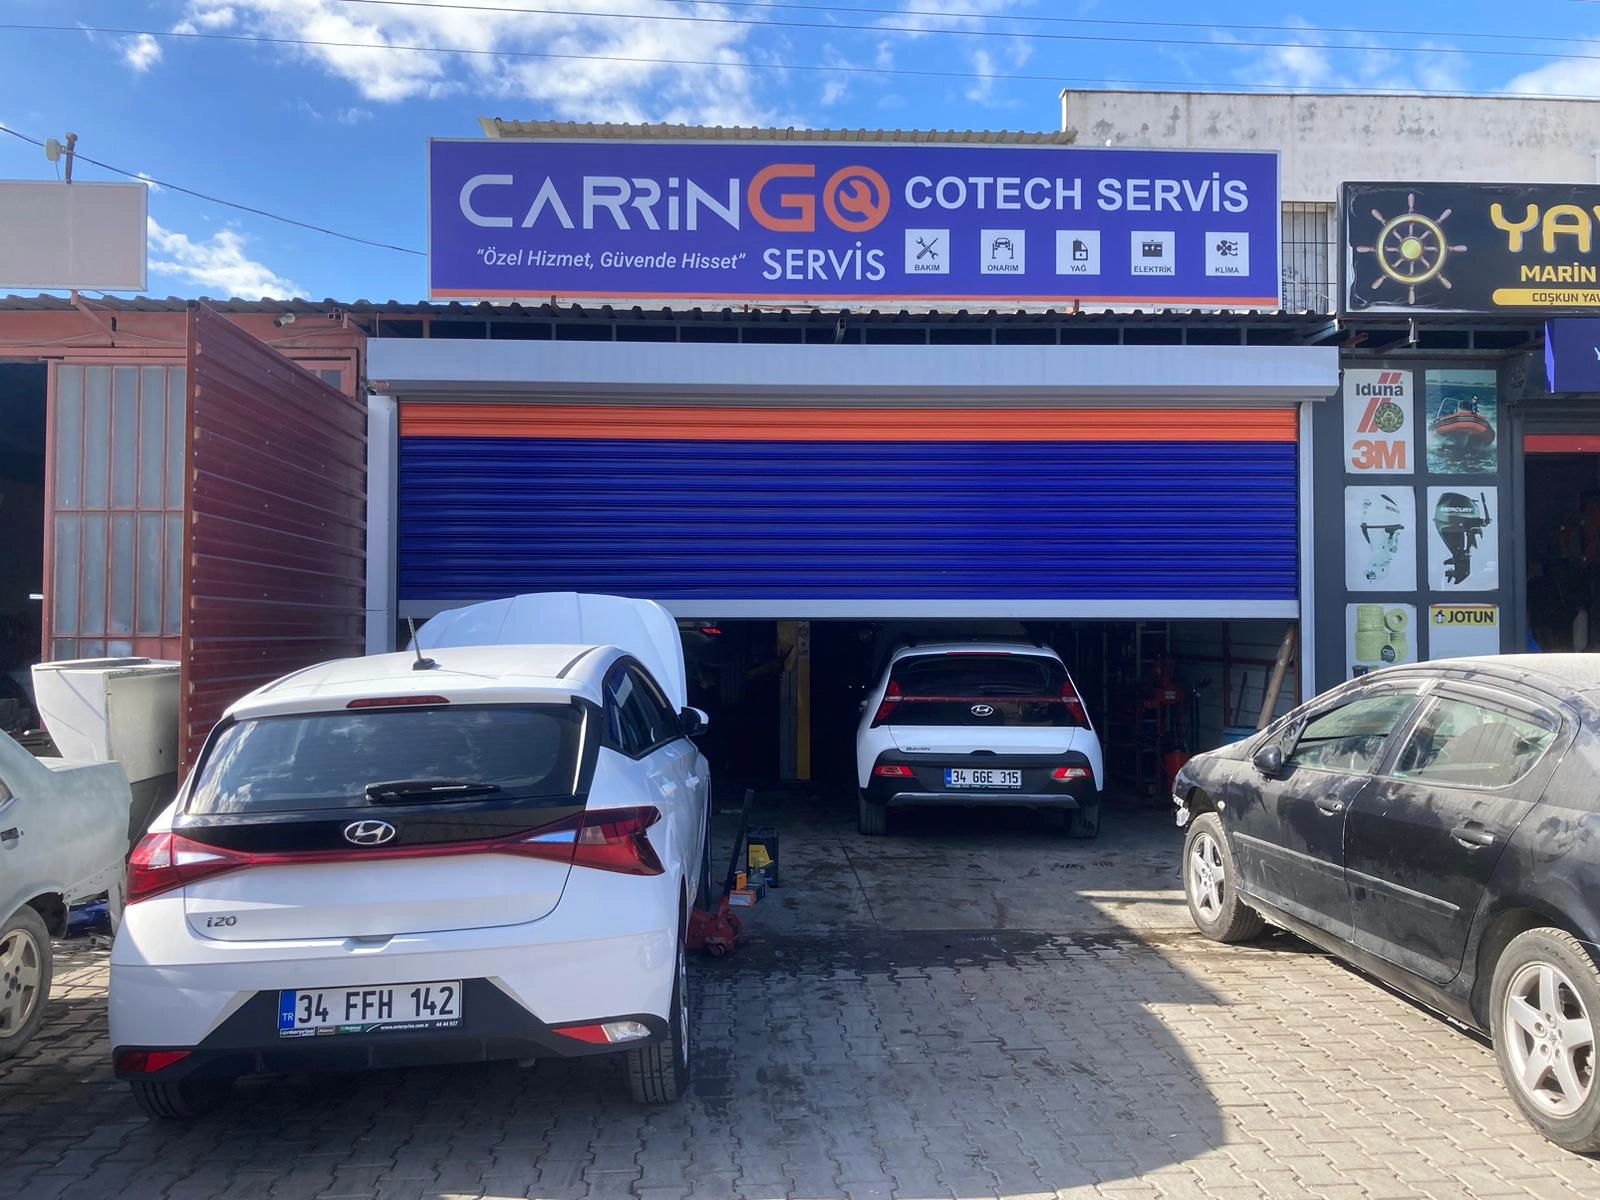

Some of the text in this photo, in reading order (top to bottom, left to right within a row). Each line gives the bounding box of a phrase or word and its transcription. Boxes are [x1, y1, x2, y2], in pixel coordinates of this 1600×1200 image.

[904, 172, 1249, 213] COTECH SERVİS
[1490, 203, 1600, 254] YA
[476, 247, 747, 270] “Özel Hizmet, Güvende Hisset”
[762, 241, 886, 281] SERVİS
[914, 264, 941, 272] BAKIM
[987, 264, 1019, 272] ONARIM
[1070, 263, 1088, 273] YAĞ
[1133, 264, 1173, 274] ELEKTRİK
[1214, 266, 1240, 274] KLİMA
[1532, 292, 1579, 305] COŞKUN
[1356, 383, 1404, 396] Iduna
[1352, 440, 1406, 469] 3M
[1448, 610, 1495, 624] JOTUN
[953, 770, 1018, 784] 34 GGE 315
[206, 915, 237, 928] i20
[282, 986, 454, 1024] TR 34 FFH 142
